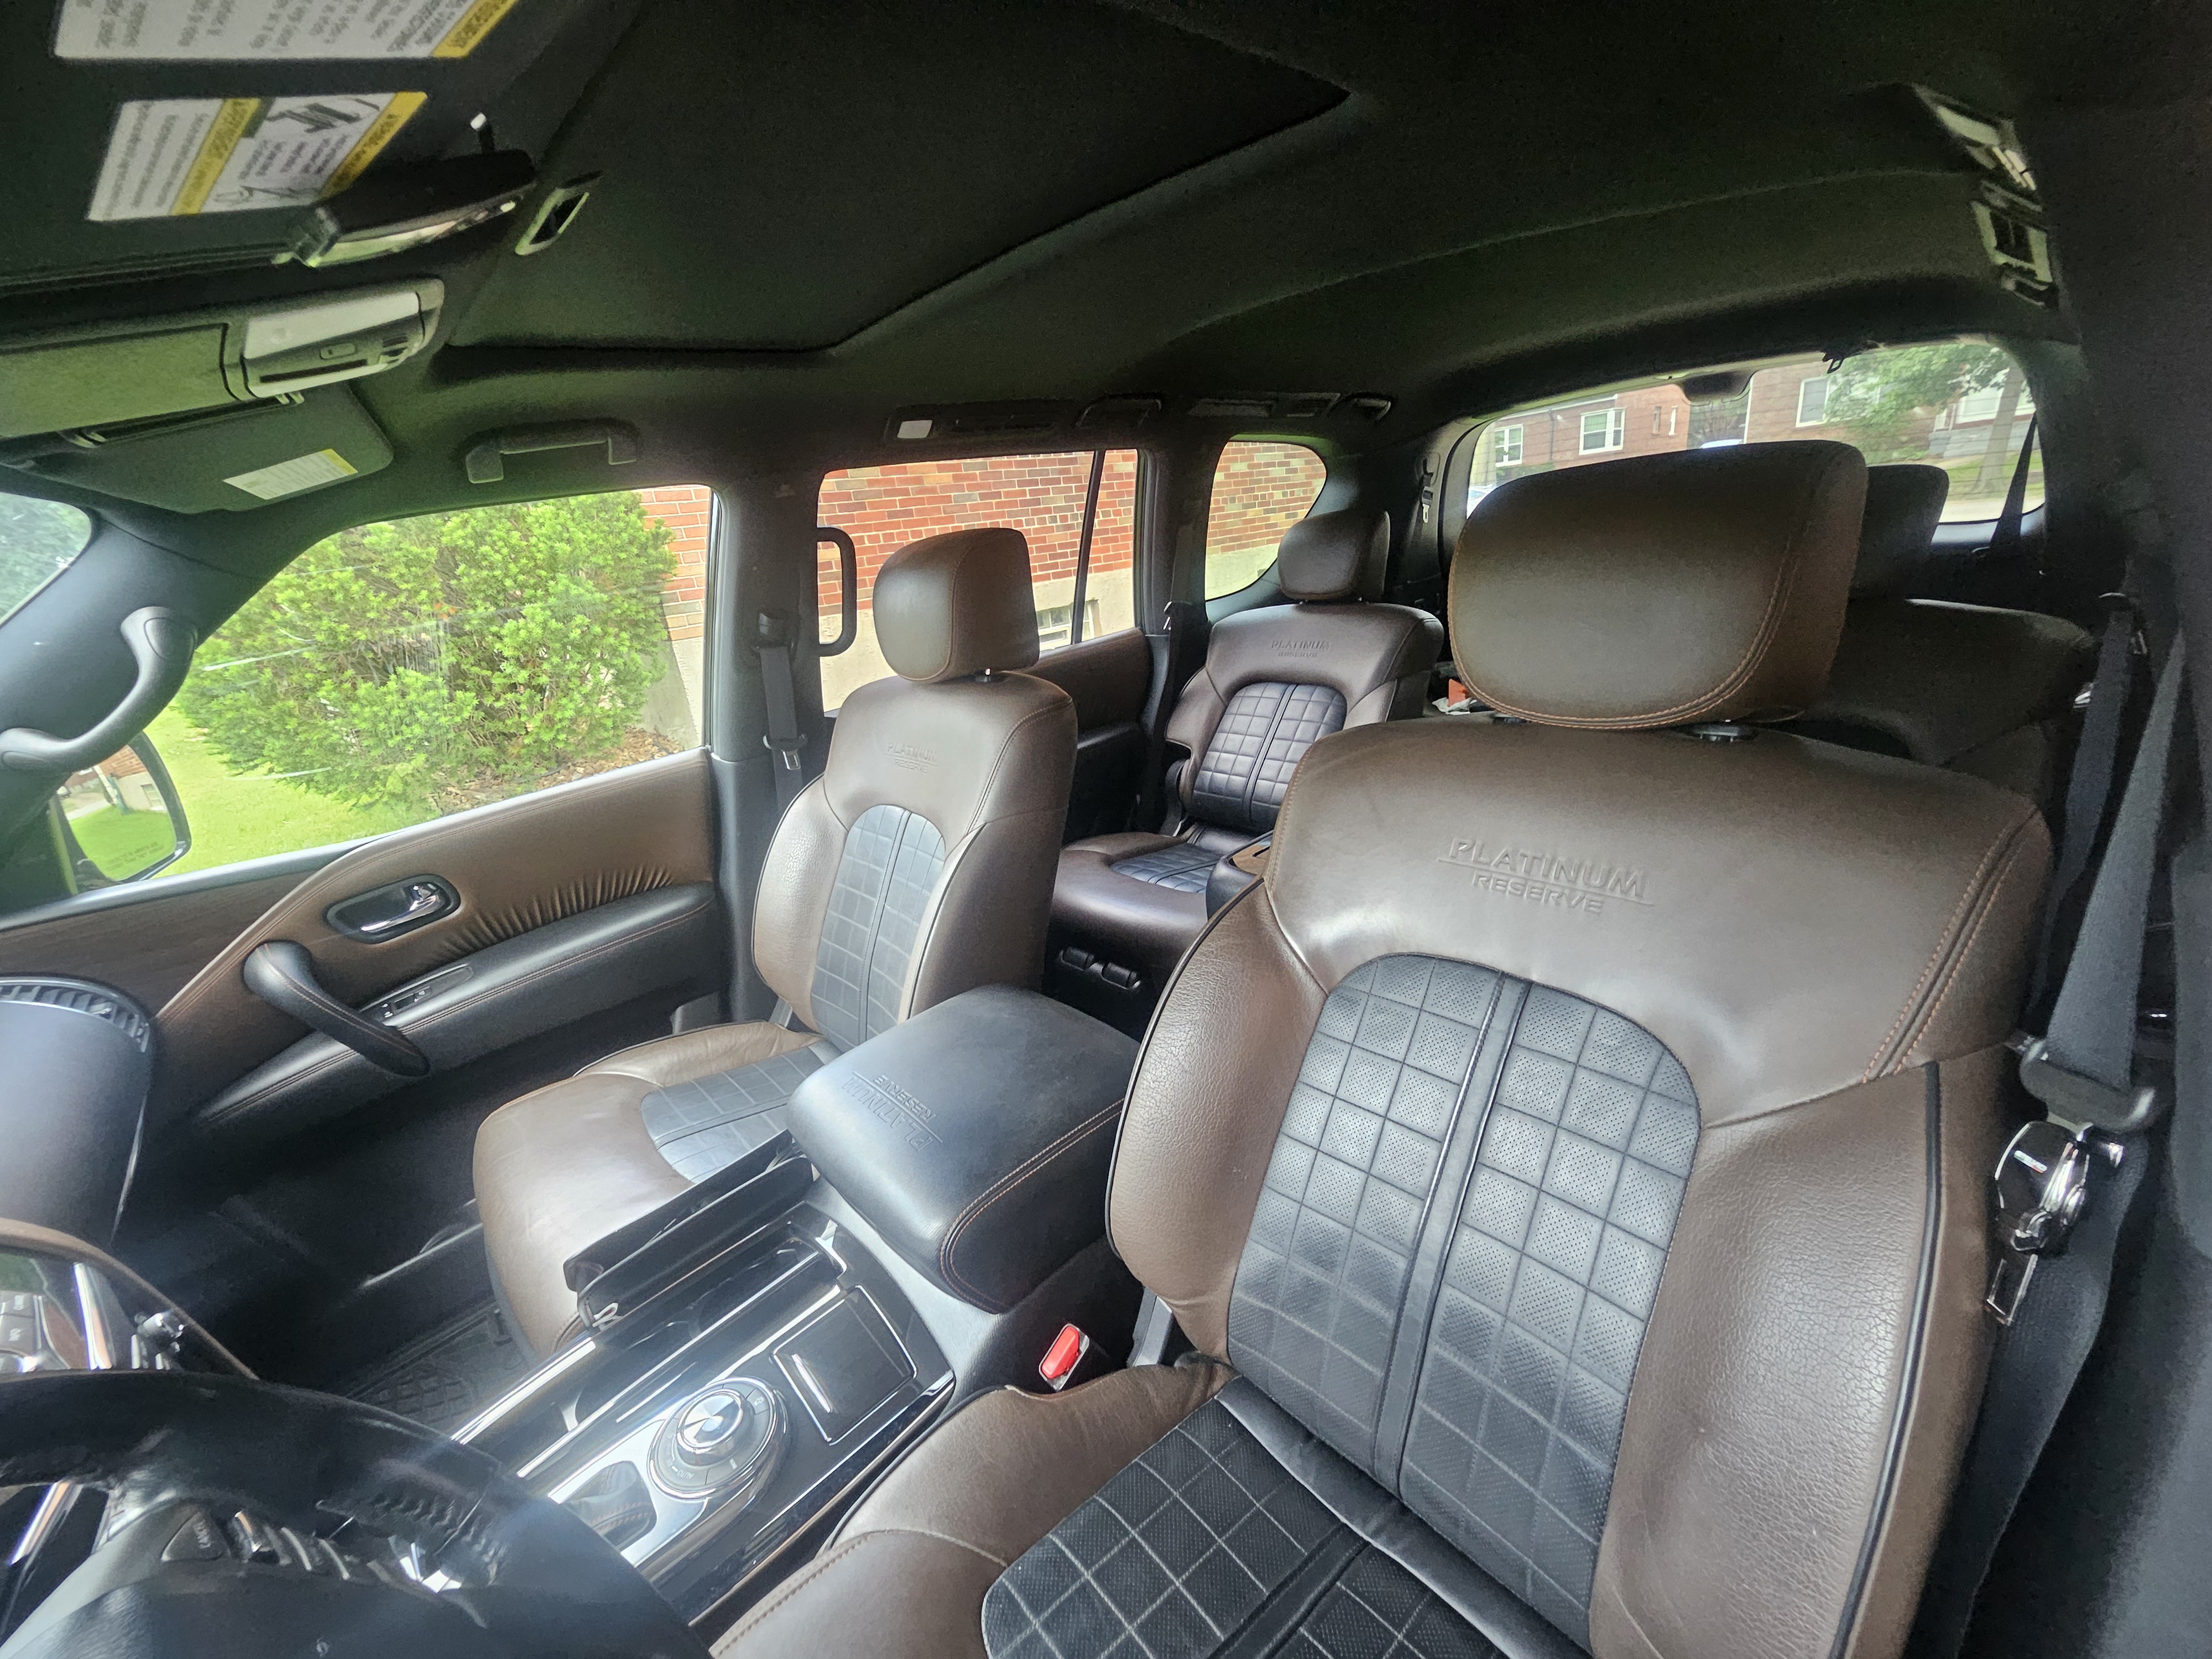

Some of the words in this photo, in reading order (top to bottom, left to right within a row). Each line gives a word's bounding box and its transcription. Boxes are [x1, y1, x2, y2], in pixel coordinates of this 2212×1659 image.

[1271, 640, 1330, 651] PLATINUM
[888, 742, 938, 761] PLATINUM
[895, 759, 928, 774] RESERVE
[1448, 837, 1645, 899] PLATINUM
[1472, 870, 1606, 914] RESERVE
[842, 1076, 933, 1151] PLATINUM
[873, 1074, 937, 1123] RESERVE
[676, 1470, 695, 1479] AUTO
